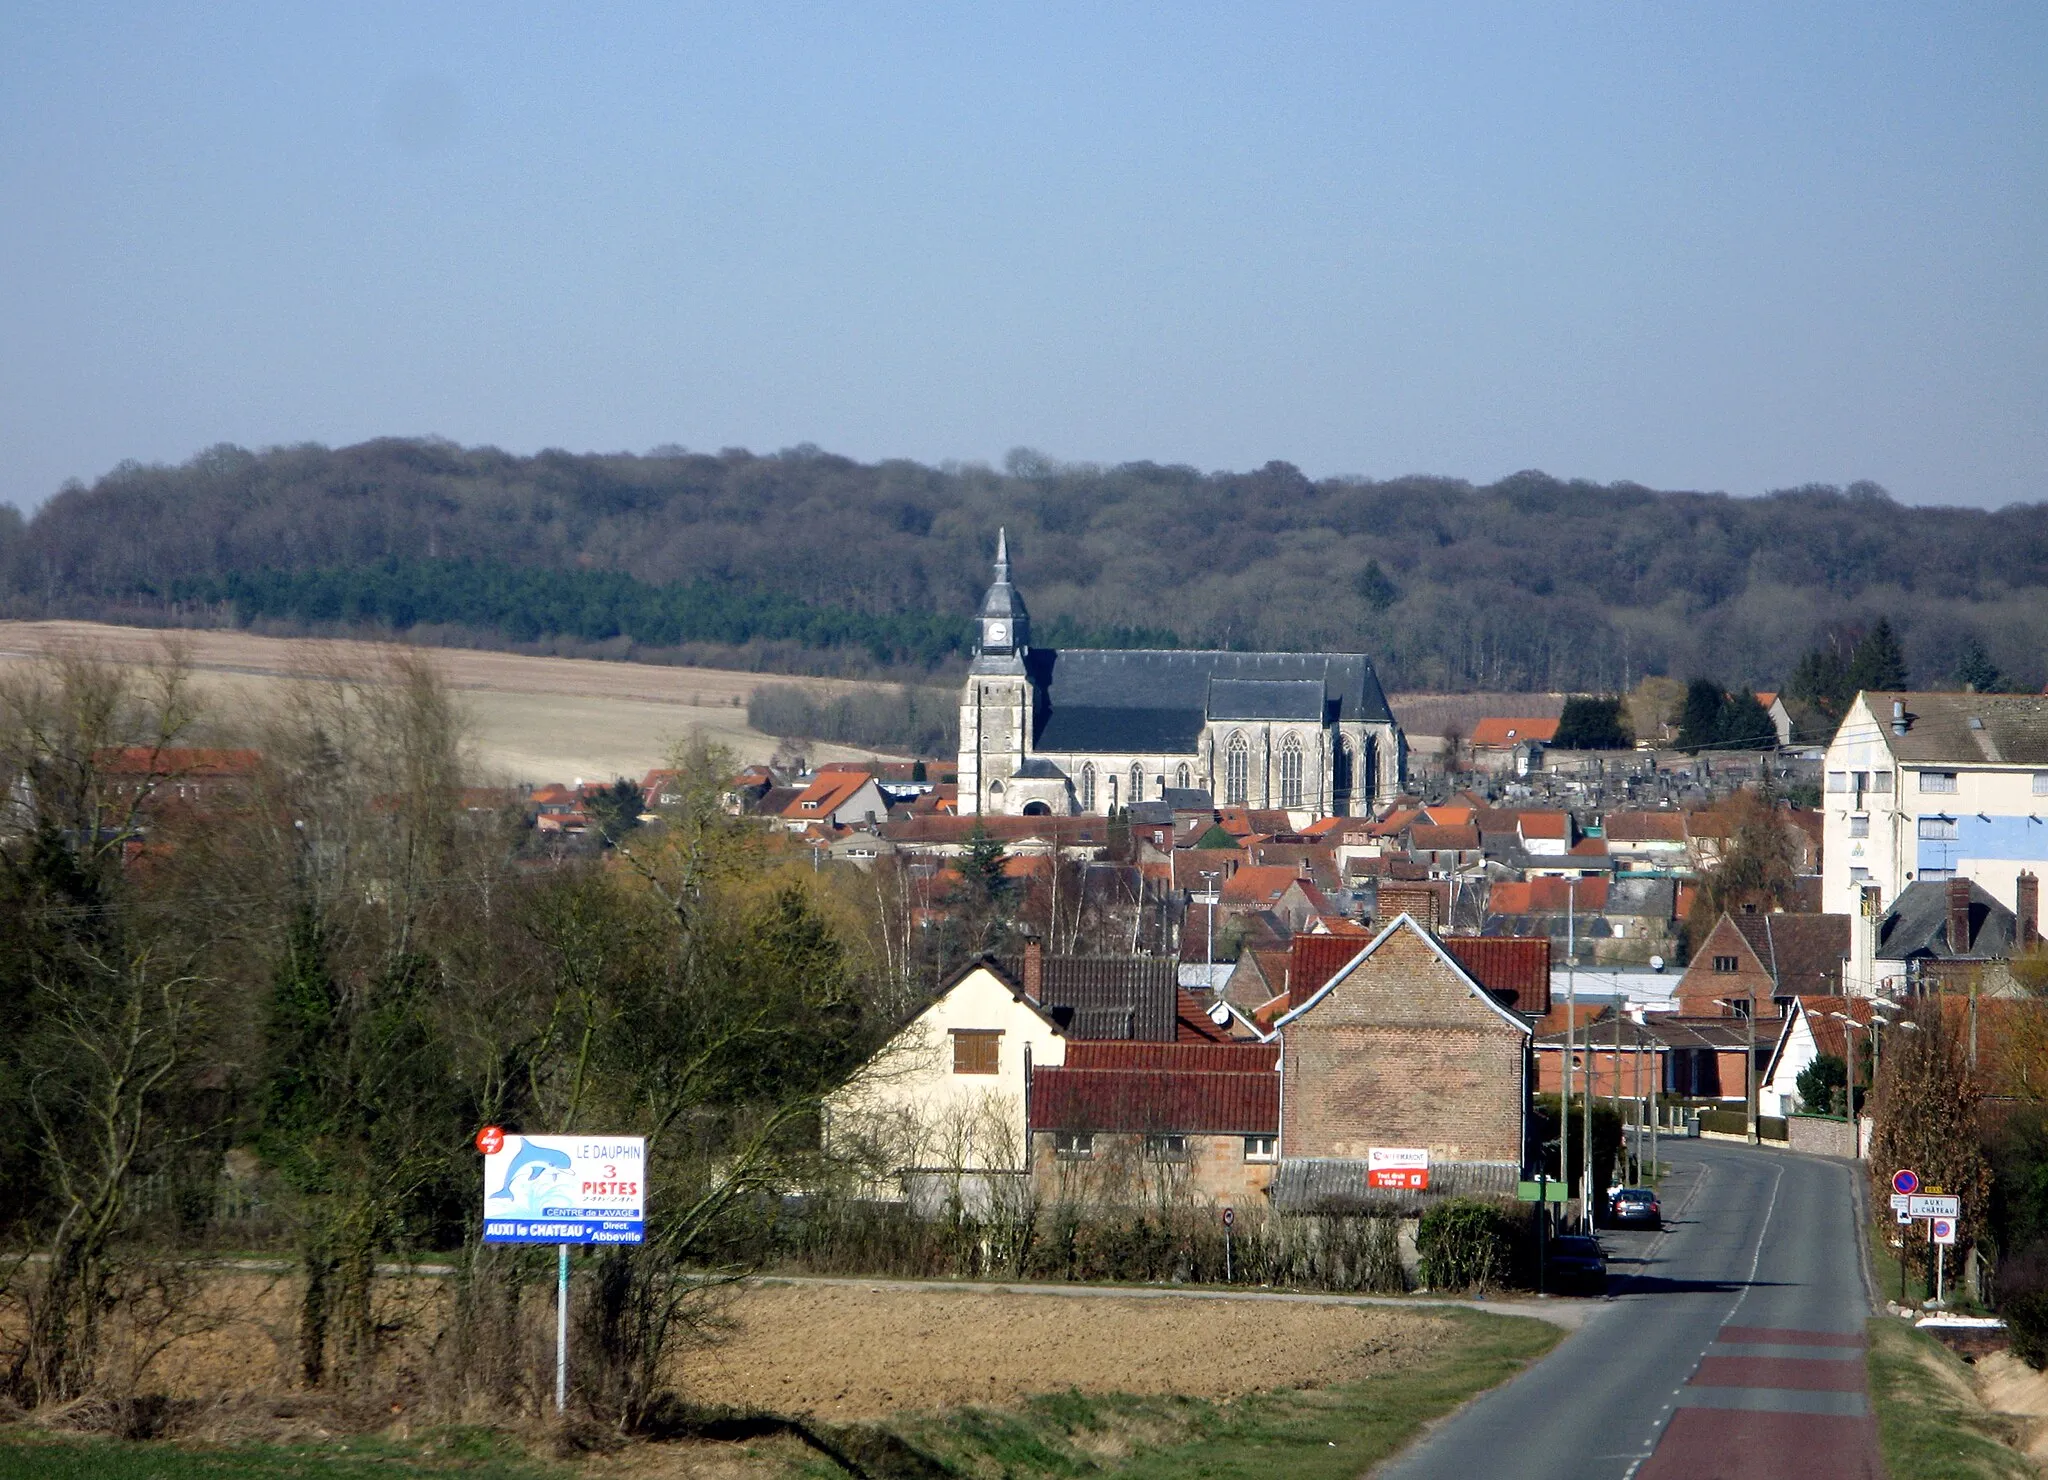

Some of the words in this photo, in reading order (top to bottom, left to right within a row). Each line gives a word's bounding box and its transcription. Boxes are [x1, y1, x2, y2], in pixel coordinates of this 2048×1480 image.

[577, 1145, 590, 1159] LE
[593, 1145, 641, 1160] DAUPHIN
[603, 1164, 617, 1178] 3
[582, 1181, 637, 1195] PISTES
[546, 1209, 584, 1217] CENTRE
[585, 1209, 597, 1217] de
[598, 1209, 635, 1217] LAVAGE
[1921, 1206, 1955, 1214] CHÂTEAU
[486, 1223, 514, 1236] AUXI
[516, 1224, 528, 1236] le
[529, 1224, 583, 1237] CHATEAU
[602, 1222, 630, 1231] Direct.
[591, 1231, 641, 1242] Abbeville
